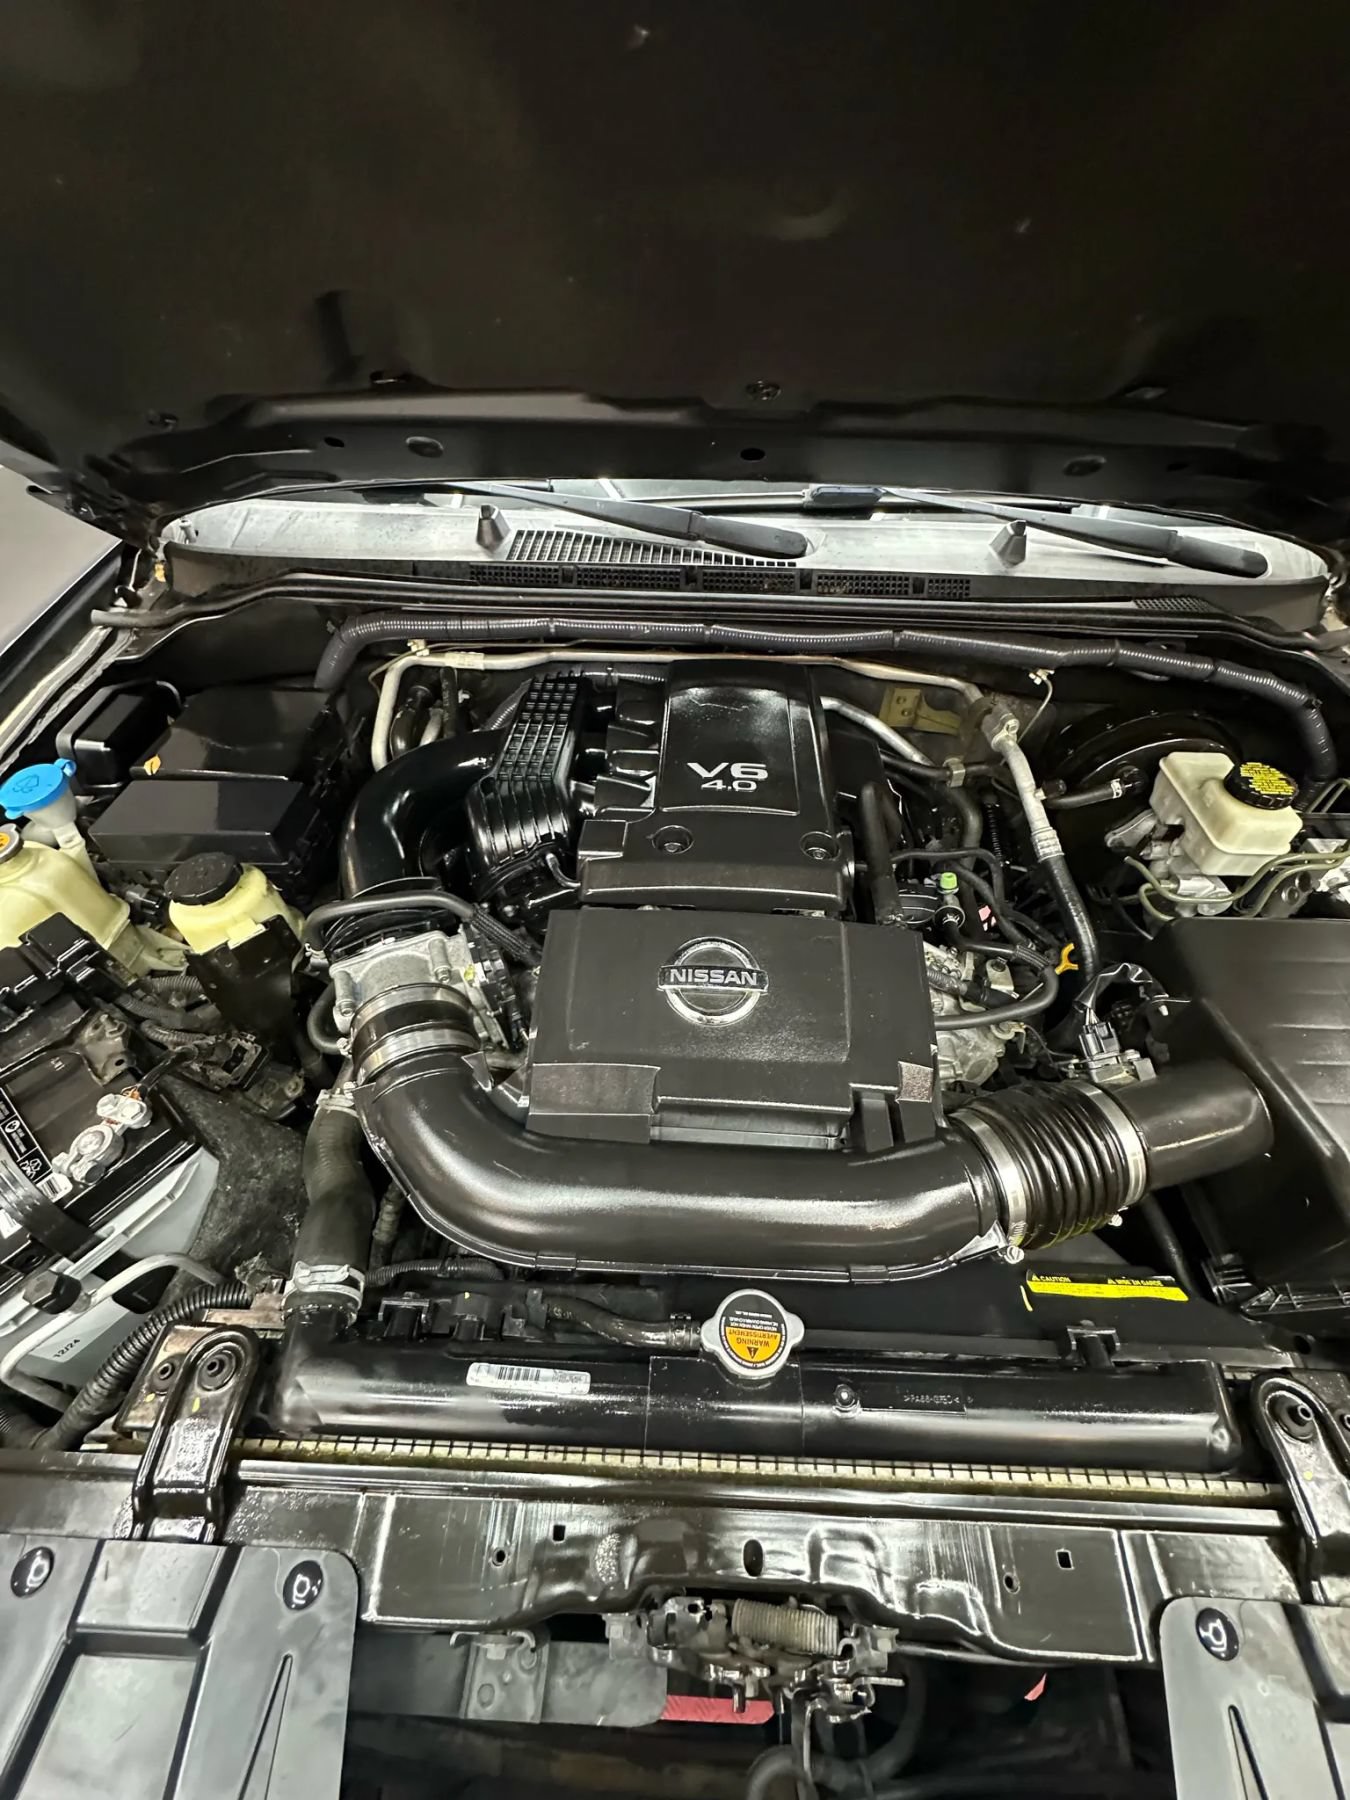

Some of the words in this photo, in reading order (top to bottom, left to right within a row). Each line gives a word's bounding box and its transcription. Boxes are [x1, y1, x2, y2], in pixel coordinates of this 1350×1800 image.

[687, 762, 769, 780] V6
[701, 779, 758, 792] 4.0
[670, 968, 758, 986] NISSAN
[729, 1329, 778, 1339] AVERTISSEMENT
[53, 1339, 81, 1358] 12/24
[737, 1337, 770, 1347] WARNING
